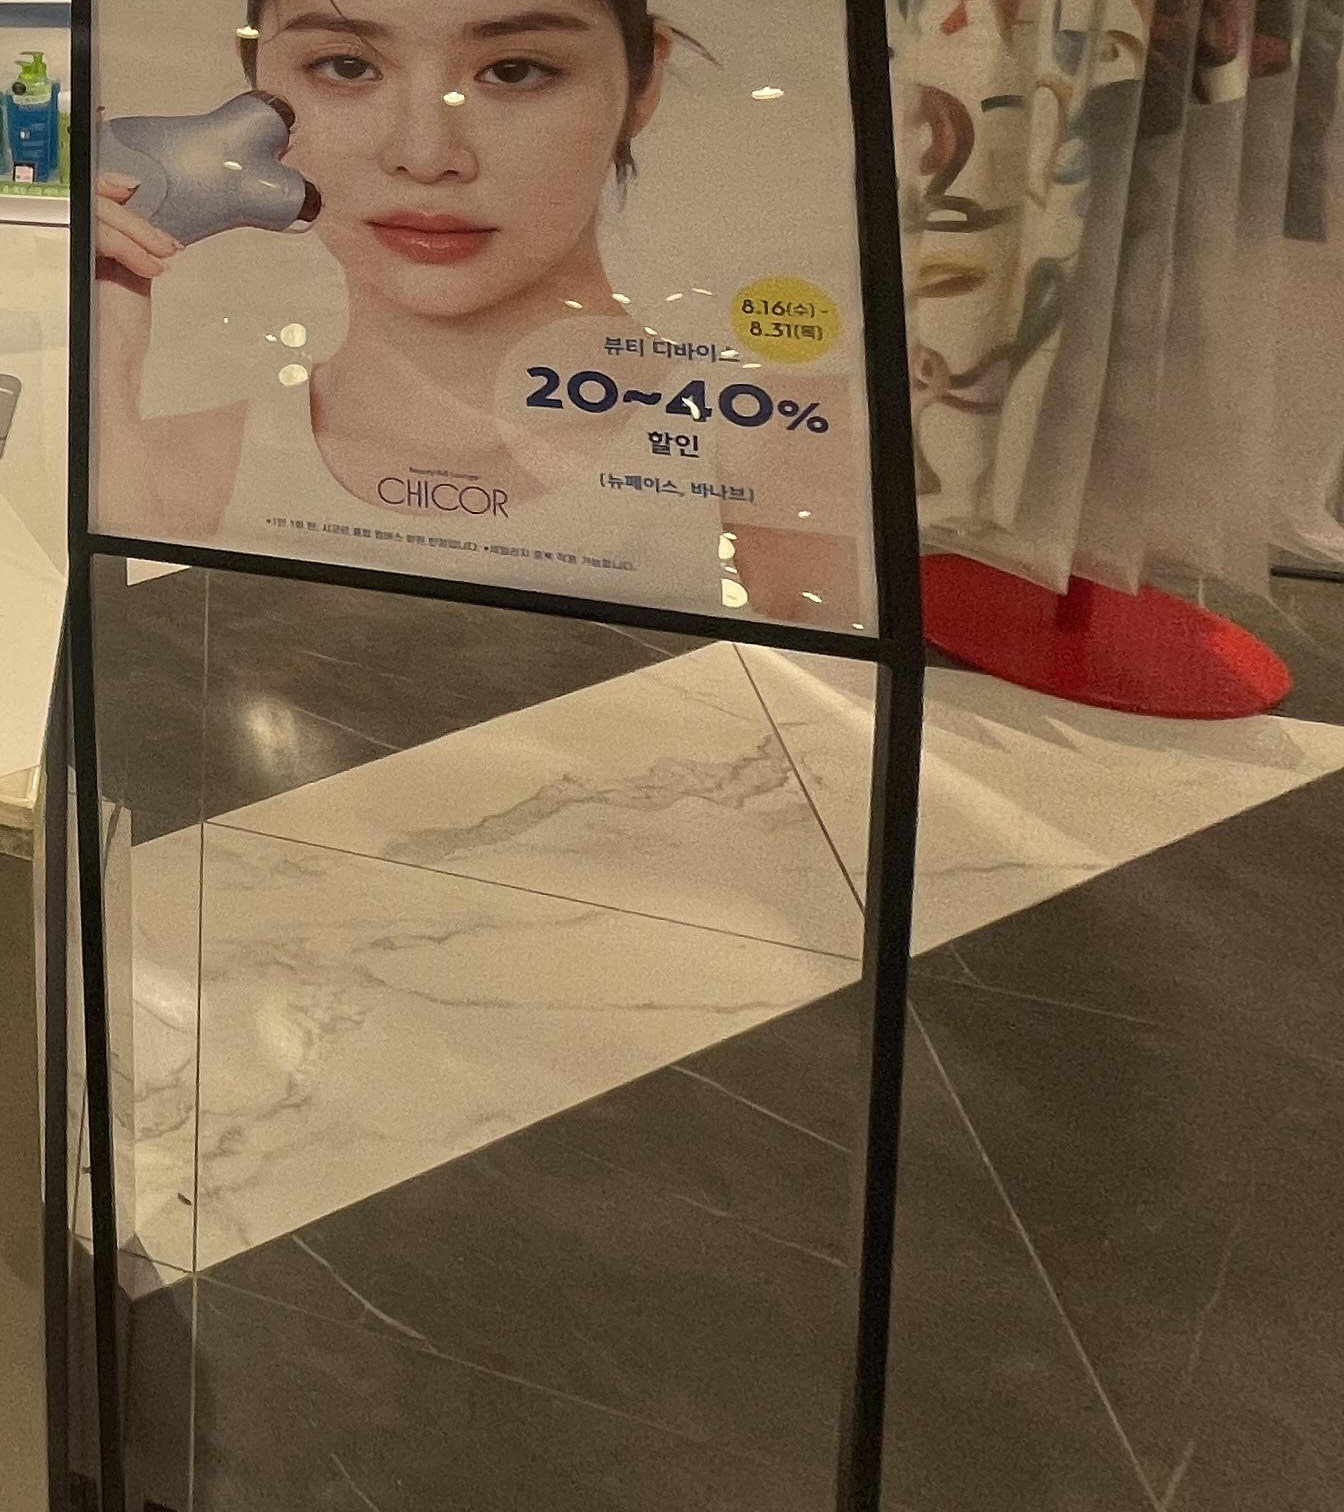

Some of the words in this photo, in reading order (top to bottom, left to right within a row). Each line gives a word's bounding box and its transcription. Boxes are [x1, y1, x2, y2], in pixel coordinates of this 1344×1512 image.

[603, 336, 645, 358] 뷰티
[652, 338, 741, 363] 디바이스
[525, 366, 830, 434] 20~40%
[648, 431, 701, 459] 할인
[377, 476, 510, 519] CHICOR
[689, 481, 756, 504] 바나브)
